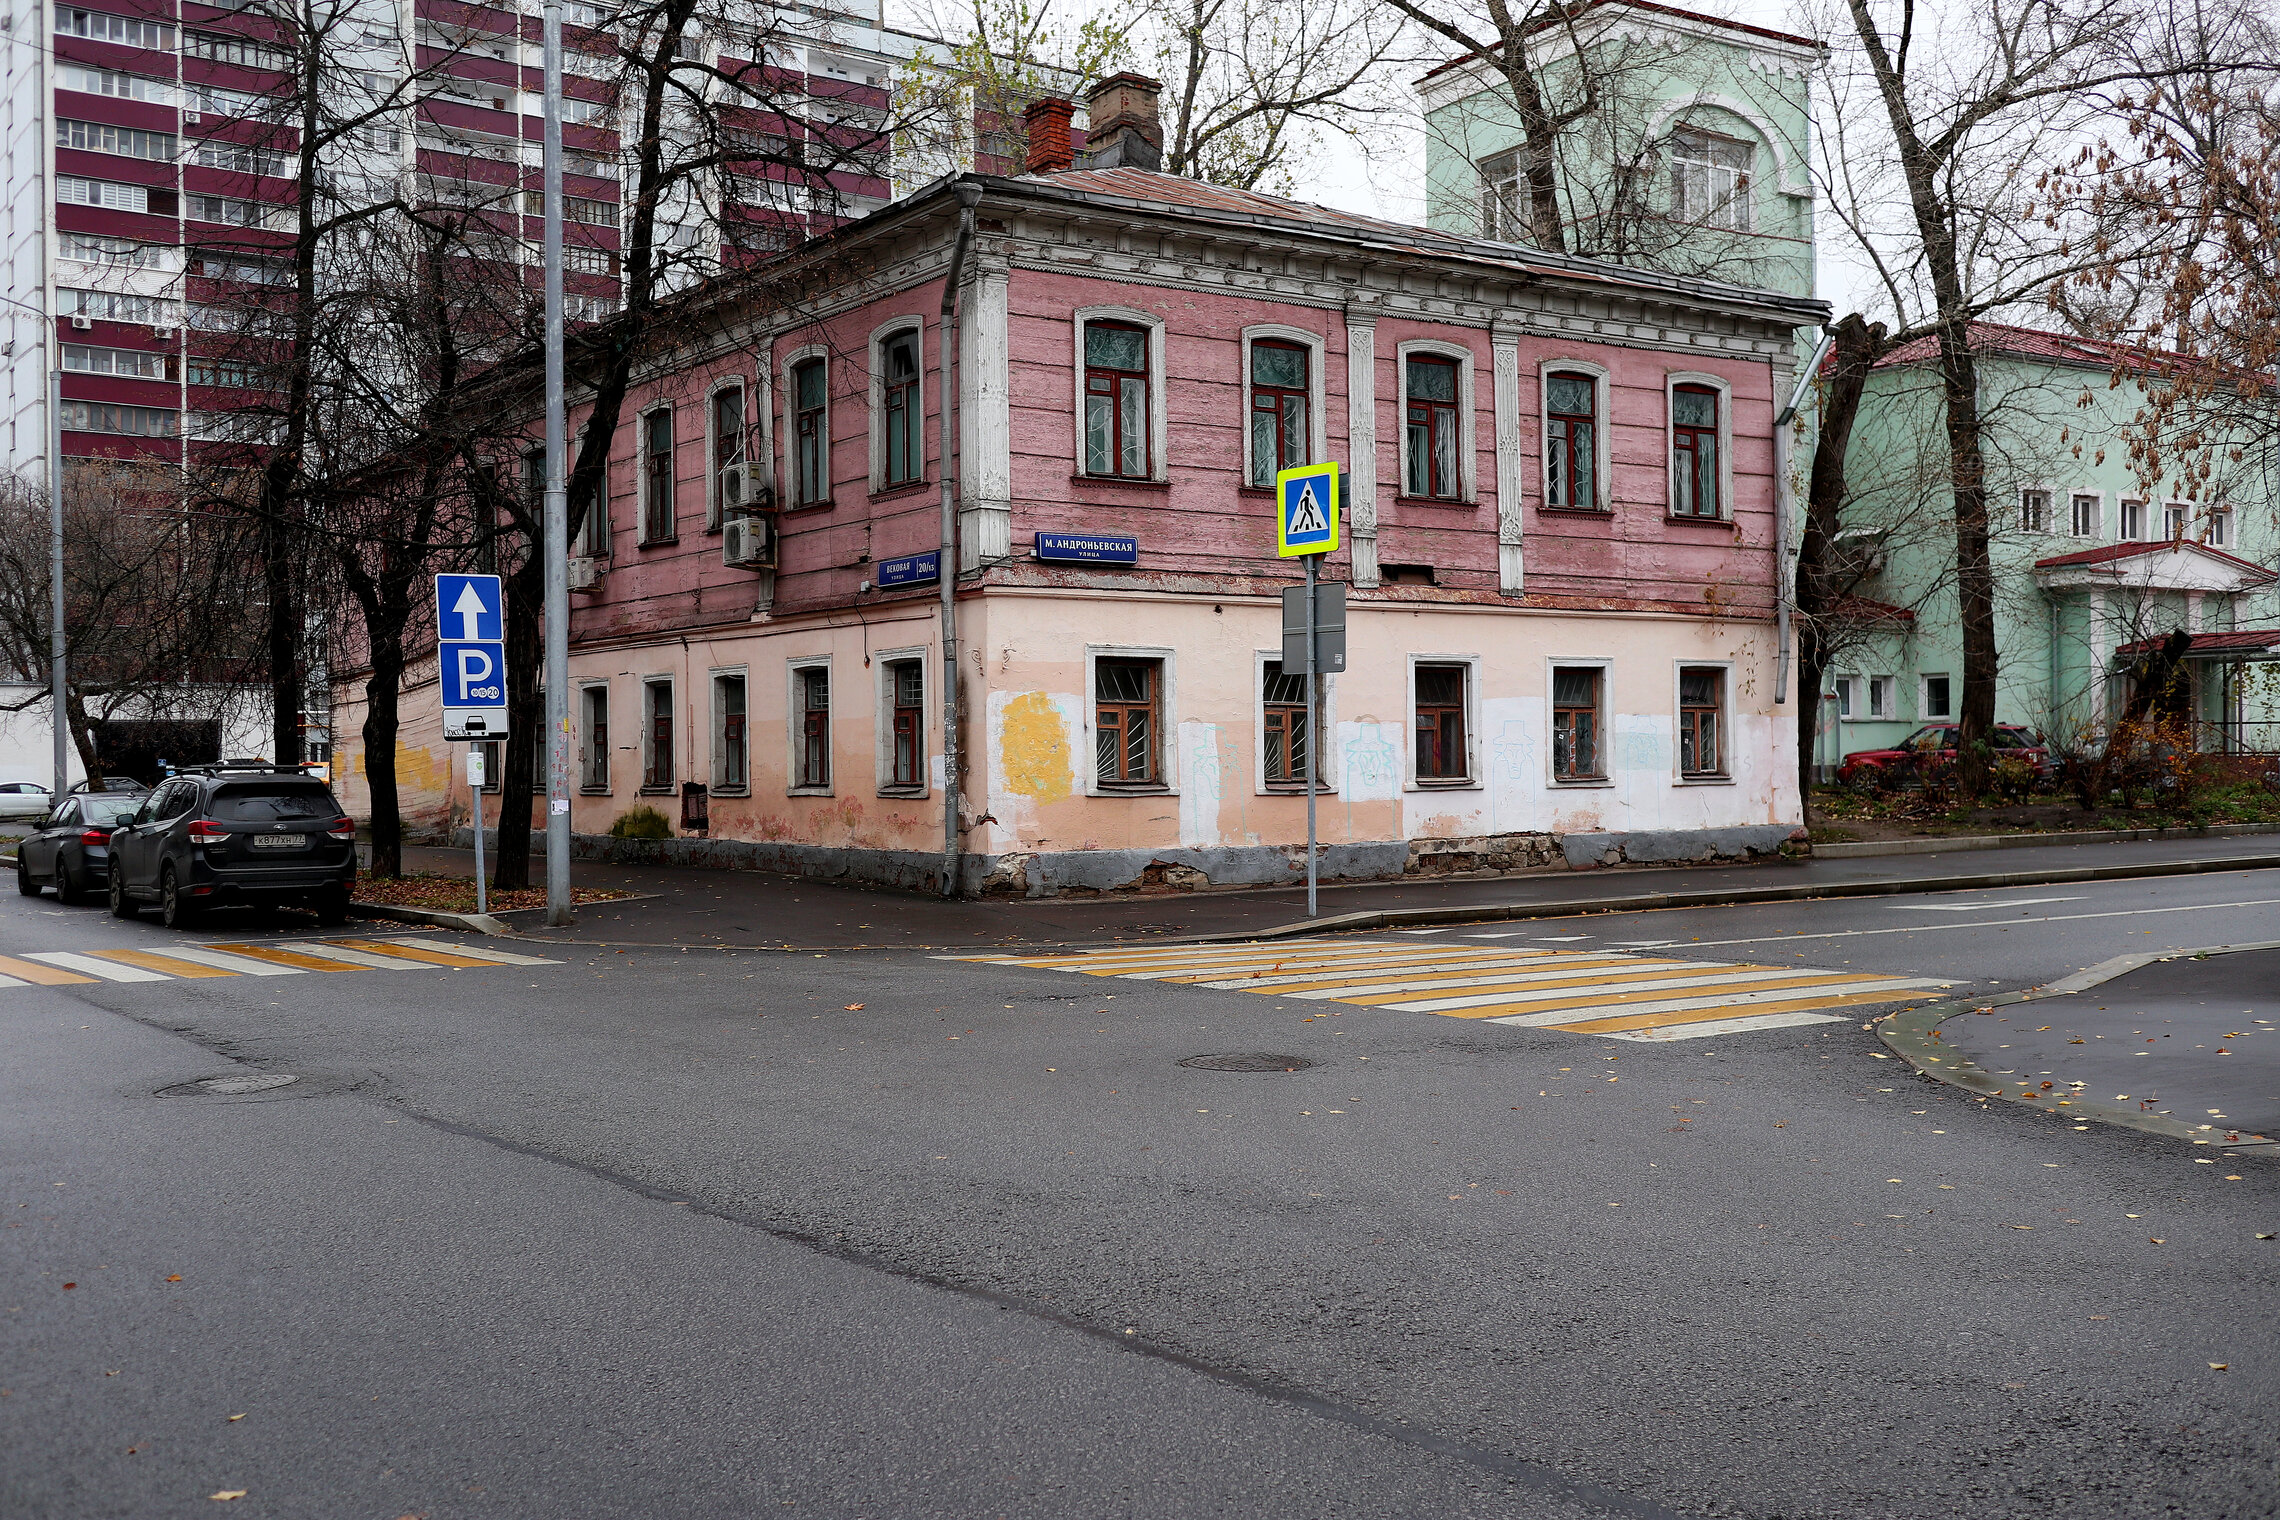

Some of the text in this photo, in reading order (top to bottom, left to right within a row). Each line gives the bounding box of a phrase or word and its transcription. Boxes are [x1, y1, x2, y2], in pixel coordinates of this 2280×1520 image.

[1045, 538, 1133, 552] М. АНДРОНЬЕВСКАЯ
[886, 561, 910, 574] ВЕКОВАЯ
[457, 649, 493, 700] P
[488, 688, 498, 697] 20
